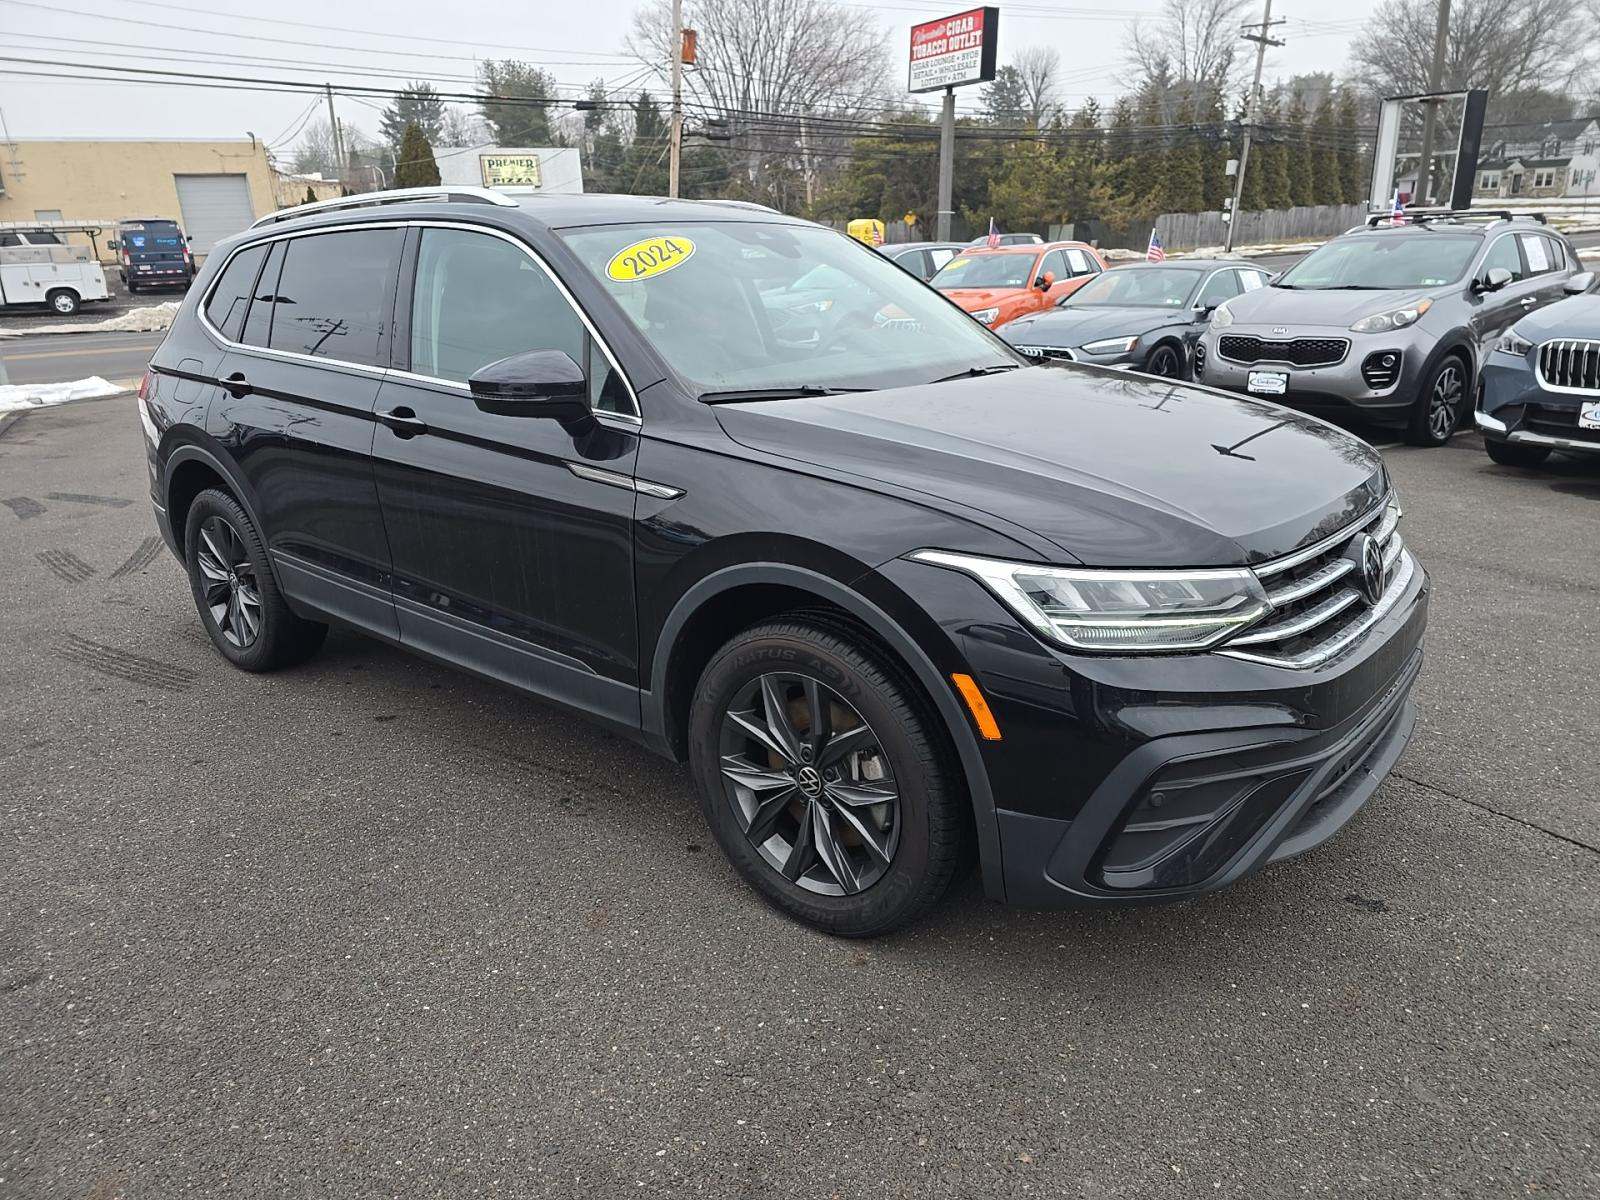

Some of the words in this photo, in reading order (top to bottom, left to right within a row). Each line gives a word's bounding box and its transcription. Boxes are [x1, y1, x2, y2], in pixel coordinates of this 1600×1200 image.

[946, 16, 974, 36] CIGAR
[912, 39, 947, 59] TOBACCO
[949, 30, 983, 50] OUTLET
[930, 54, 956, 67] LOUNGE
[913, 69, 934, 80] RETAIL
[939, 60, 977, 73] WHOLESALE
[952, 71, 967, 81] ATM
[487, 159, 534, 169] PREMIER
[492, 177, 533, 185] PIZZA
[623, 239, 684, 276] 2024
